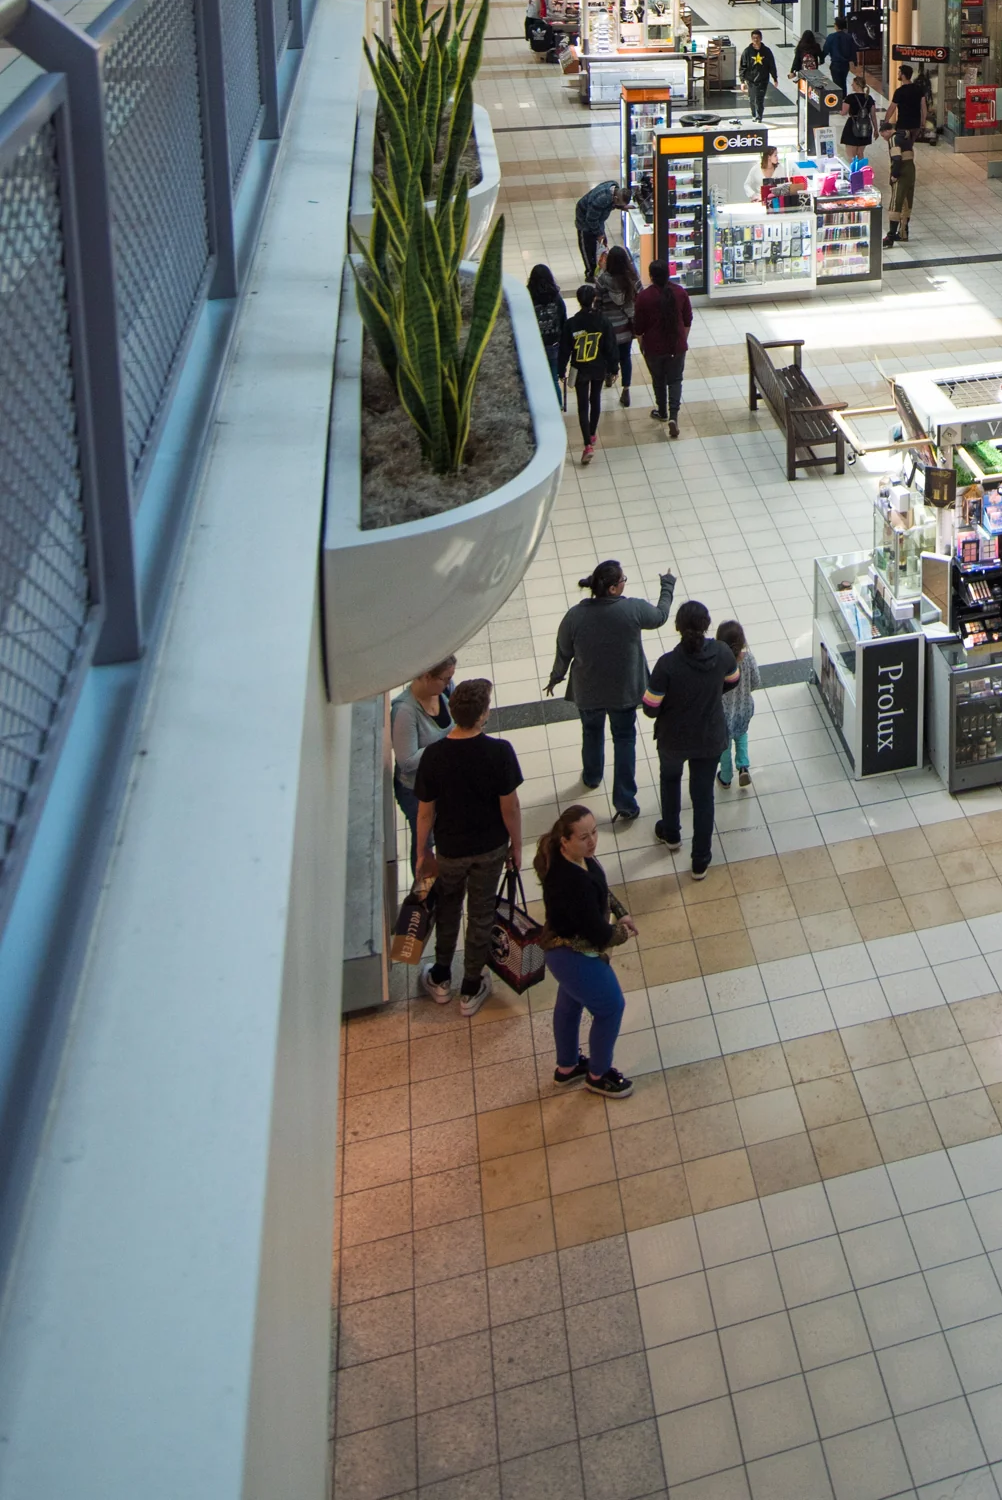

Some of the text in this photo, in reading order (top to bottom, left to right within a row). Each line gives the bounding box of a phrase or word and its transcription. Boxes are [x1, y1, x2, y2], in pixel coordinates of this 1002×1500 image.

[901, 49, 936, 57] DIVISION
[877, 661, 904, 753] Prolux
[400, 911, 421, 958] HOLLISTER
